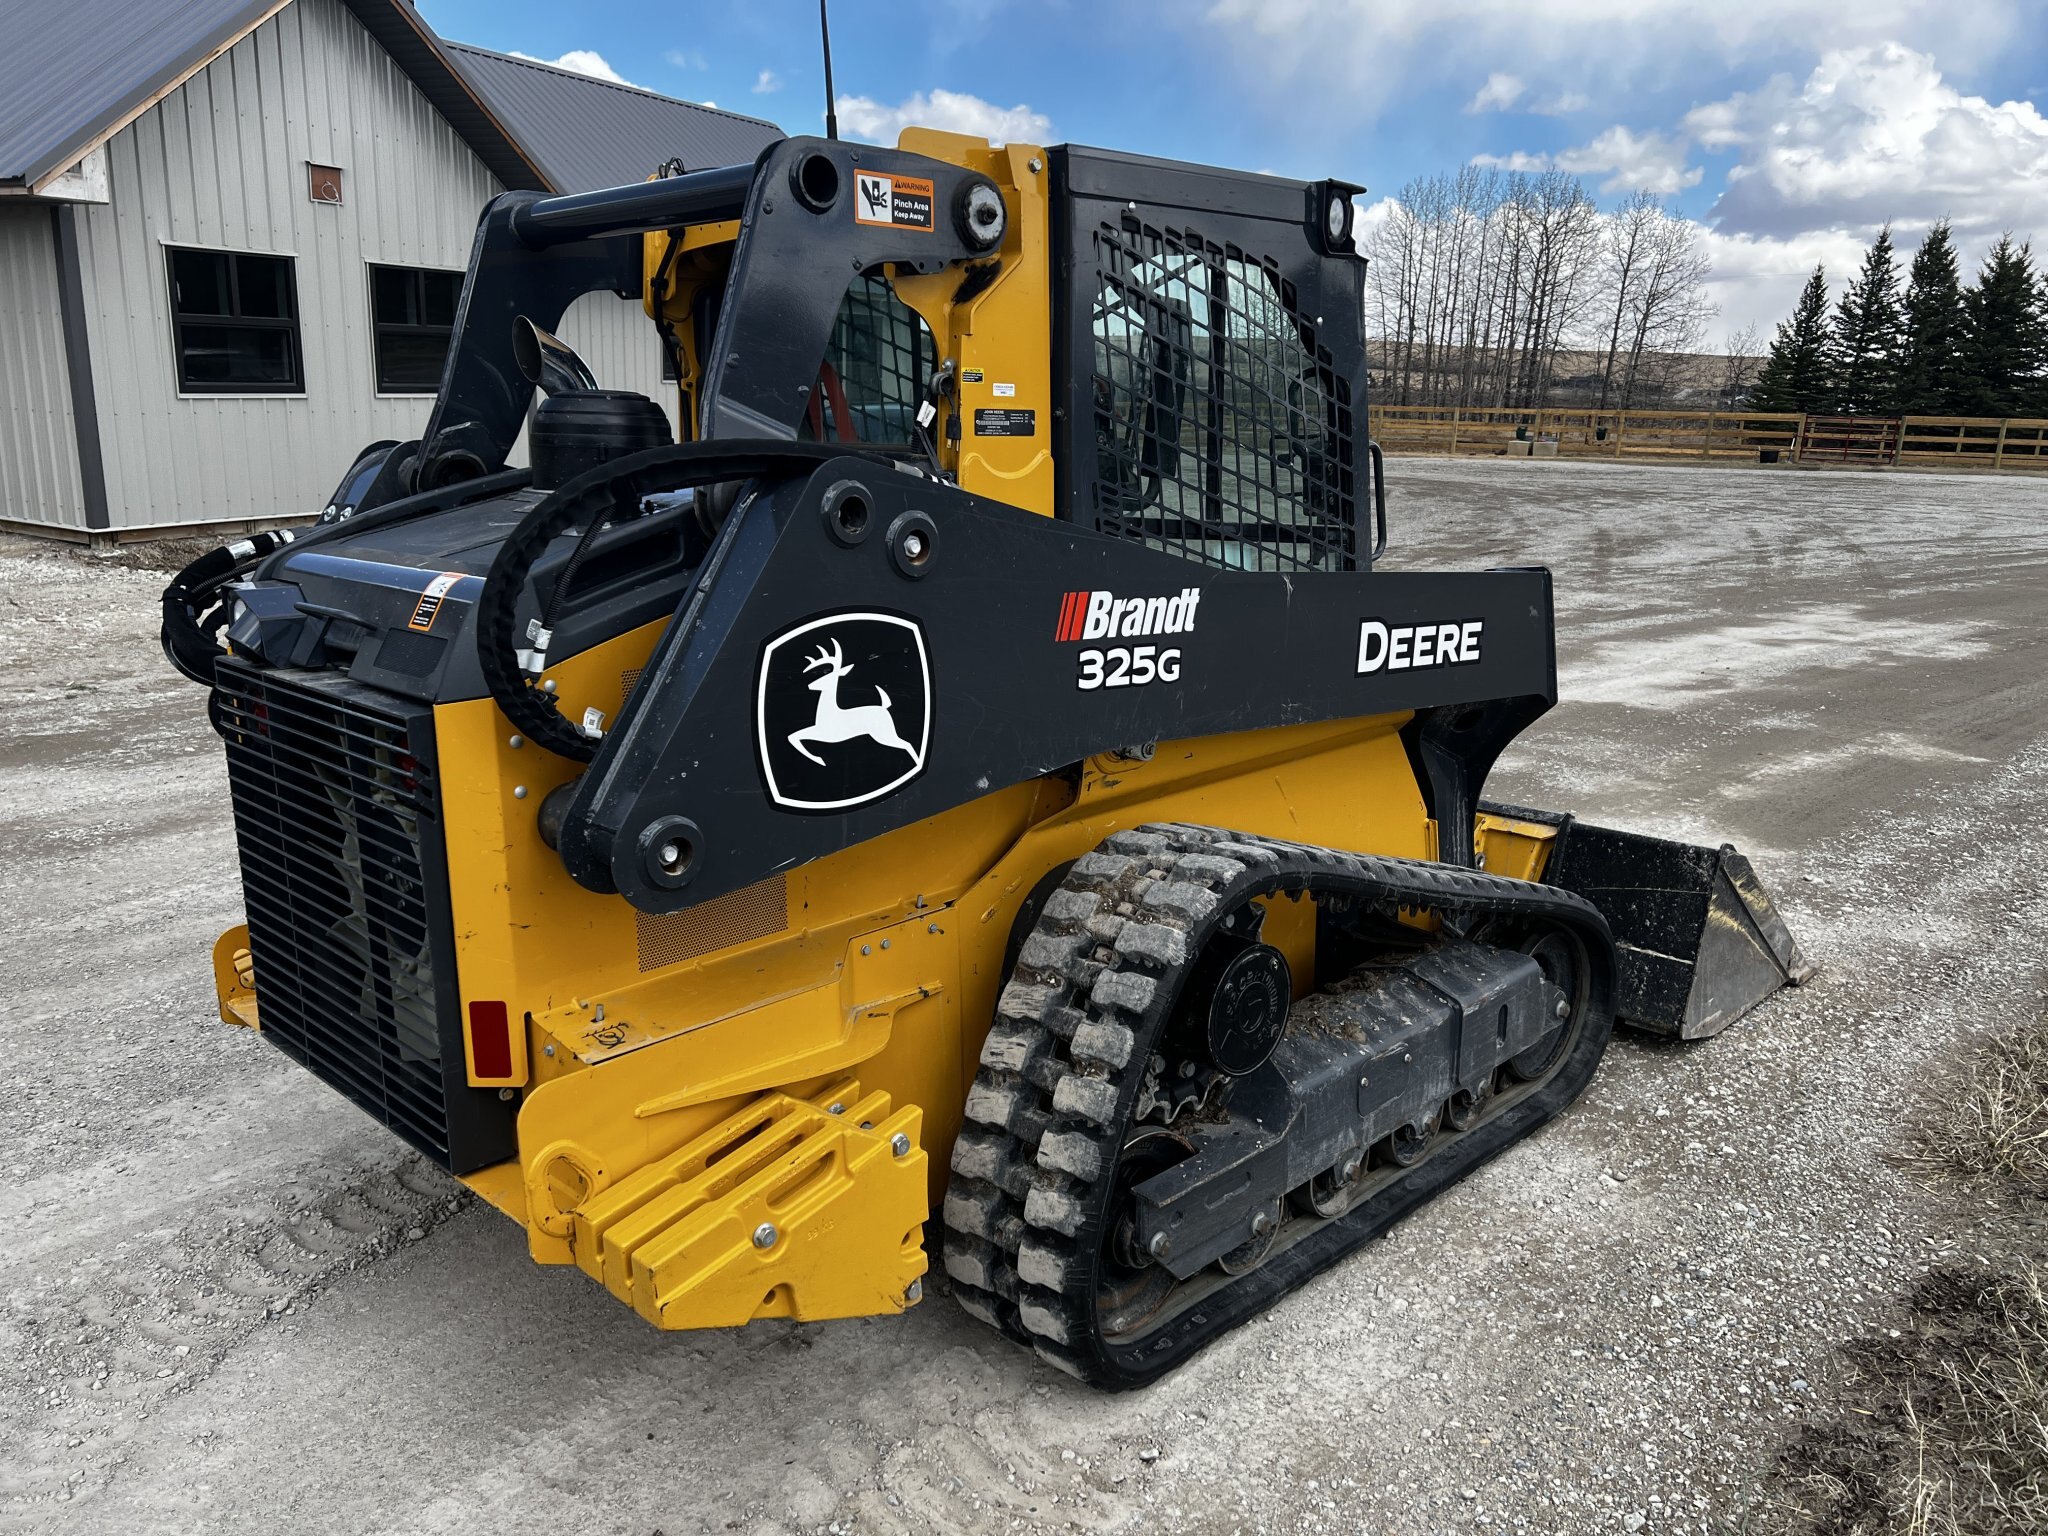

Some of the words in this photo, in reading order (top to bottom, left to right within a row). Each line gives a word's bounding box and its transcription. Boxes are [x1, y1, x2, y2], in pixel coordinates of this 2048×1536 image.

[901, 182, 930, 192] WARNING
[894, 199, 913, 210] Pinch
[913, 202, 929, 211] Area
[894, 210, 909, 220] Keep
[909, 212, 925, 222] Away
[1082, 588, 1200, 640] Brandt
[1357, 621, 1483, 673] DEERE
[1078, 646, 1181, 690] 325G
